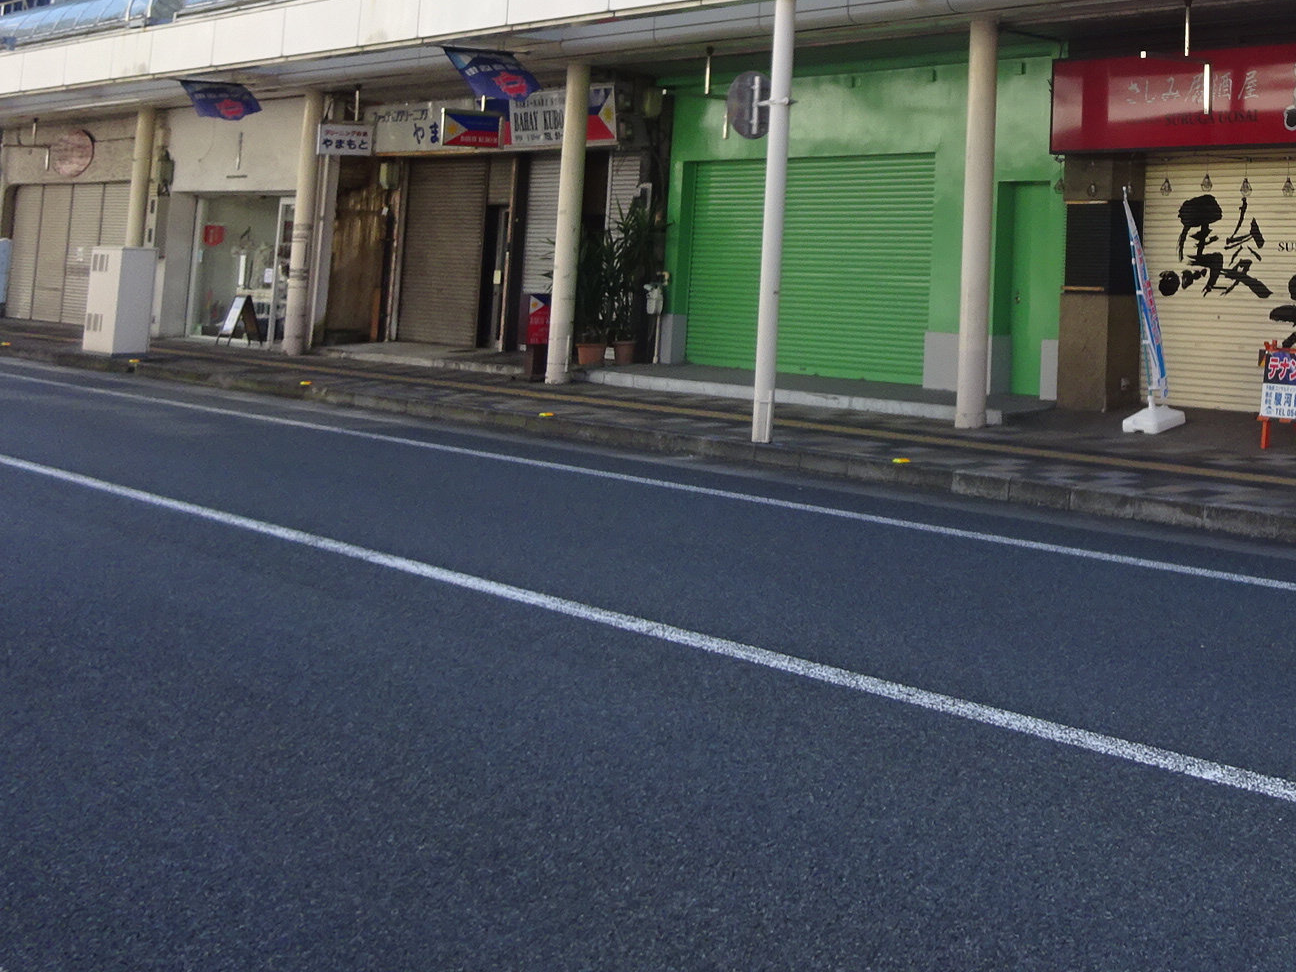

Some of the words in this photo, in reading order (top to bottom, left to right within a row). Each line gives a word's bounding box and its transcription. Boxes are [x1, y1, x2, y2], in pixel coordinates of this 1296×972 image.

[1165, 112, 1215, 126] SURUGA
[1219, 109, 1258, 124] UOSAI
[322, 137, 369, 150] やまもと
[1275, 407, 1285, 416] TEL
